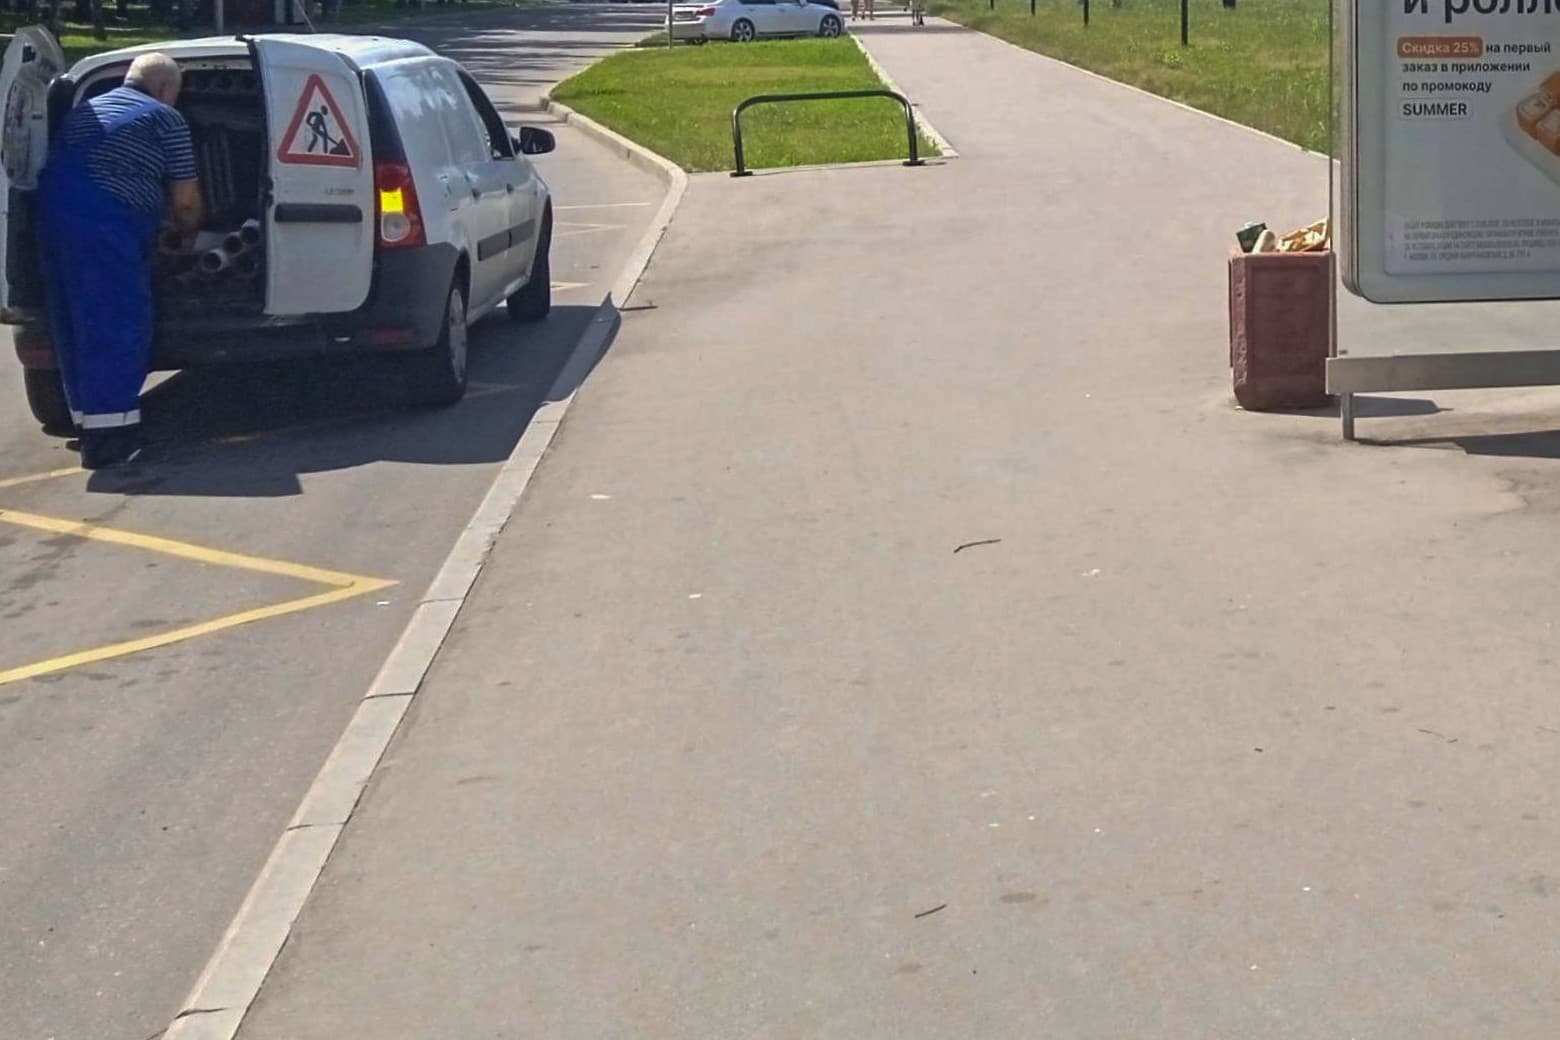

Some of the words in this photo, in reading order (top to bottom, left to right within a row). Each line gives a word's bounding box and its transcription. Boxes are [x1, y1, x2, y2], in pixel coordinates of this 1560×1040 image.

[1402, 41, 1450, 55] Скидка
[1452, 41, 1481, 54] 25%
[1485, 44, 1501, 54] на
[1503, 41, 1551, 55] первый
[1402, 63, 1438, 73] заказ
[1440, 63, 1449, 73] в
[1451, 62, 1531, 75] приложении
[1402, 81, 1418, 92] по
[1421, 80, 1492, 94] промокоду
[1402, 102, 1468, 117] SUMMER
